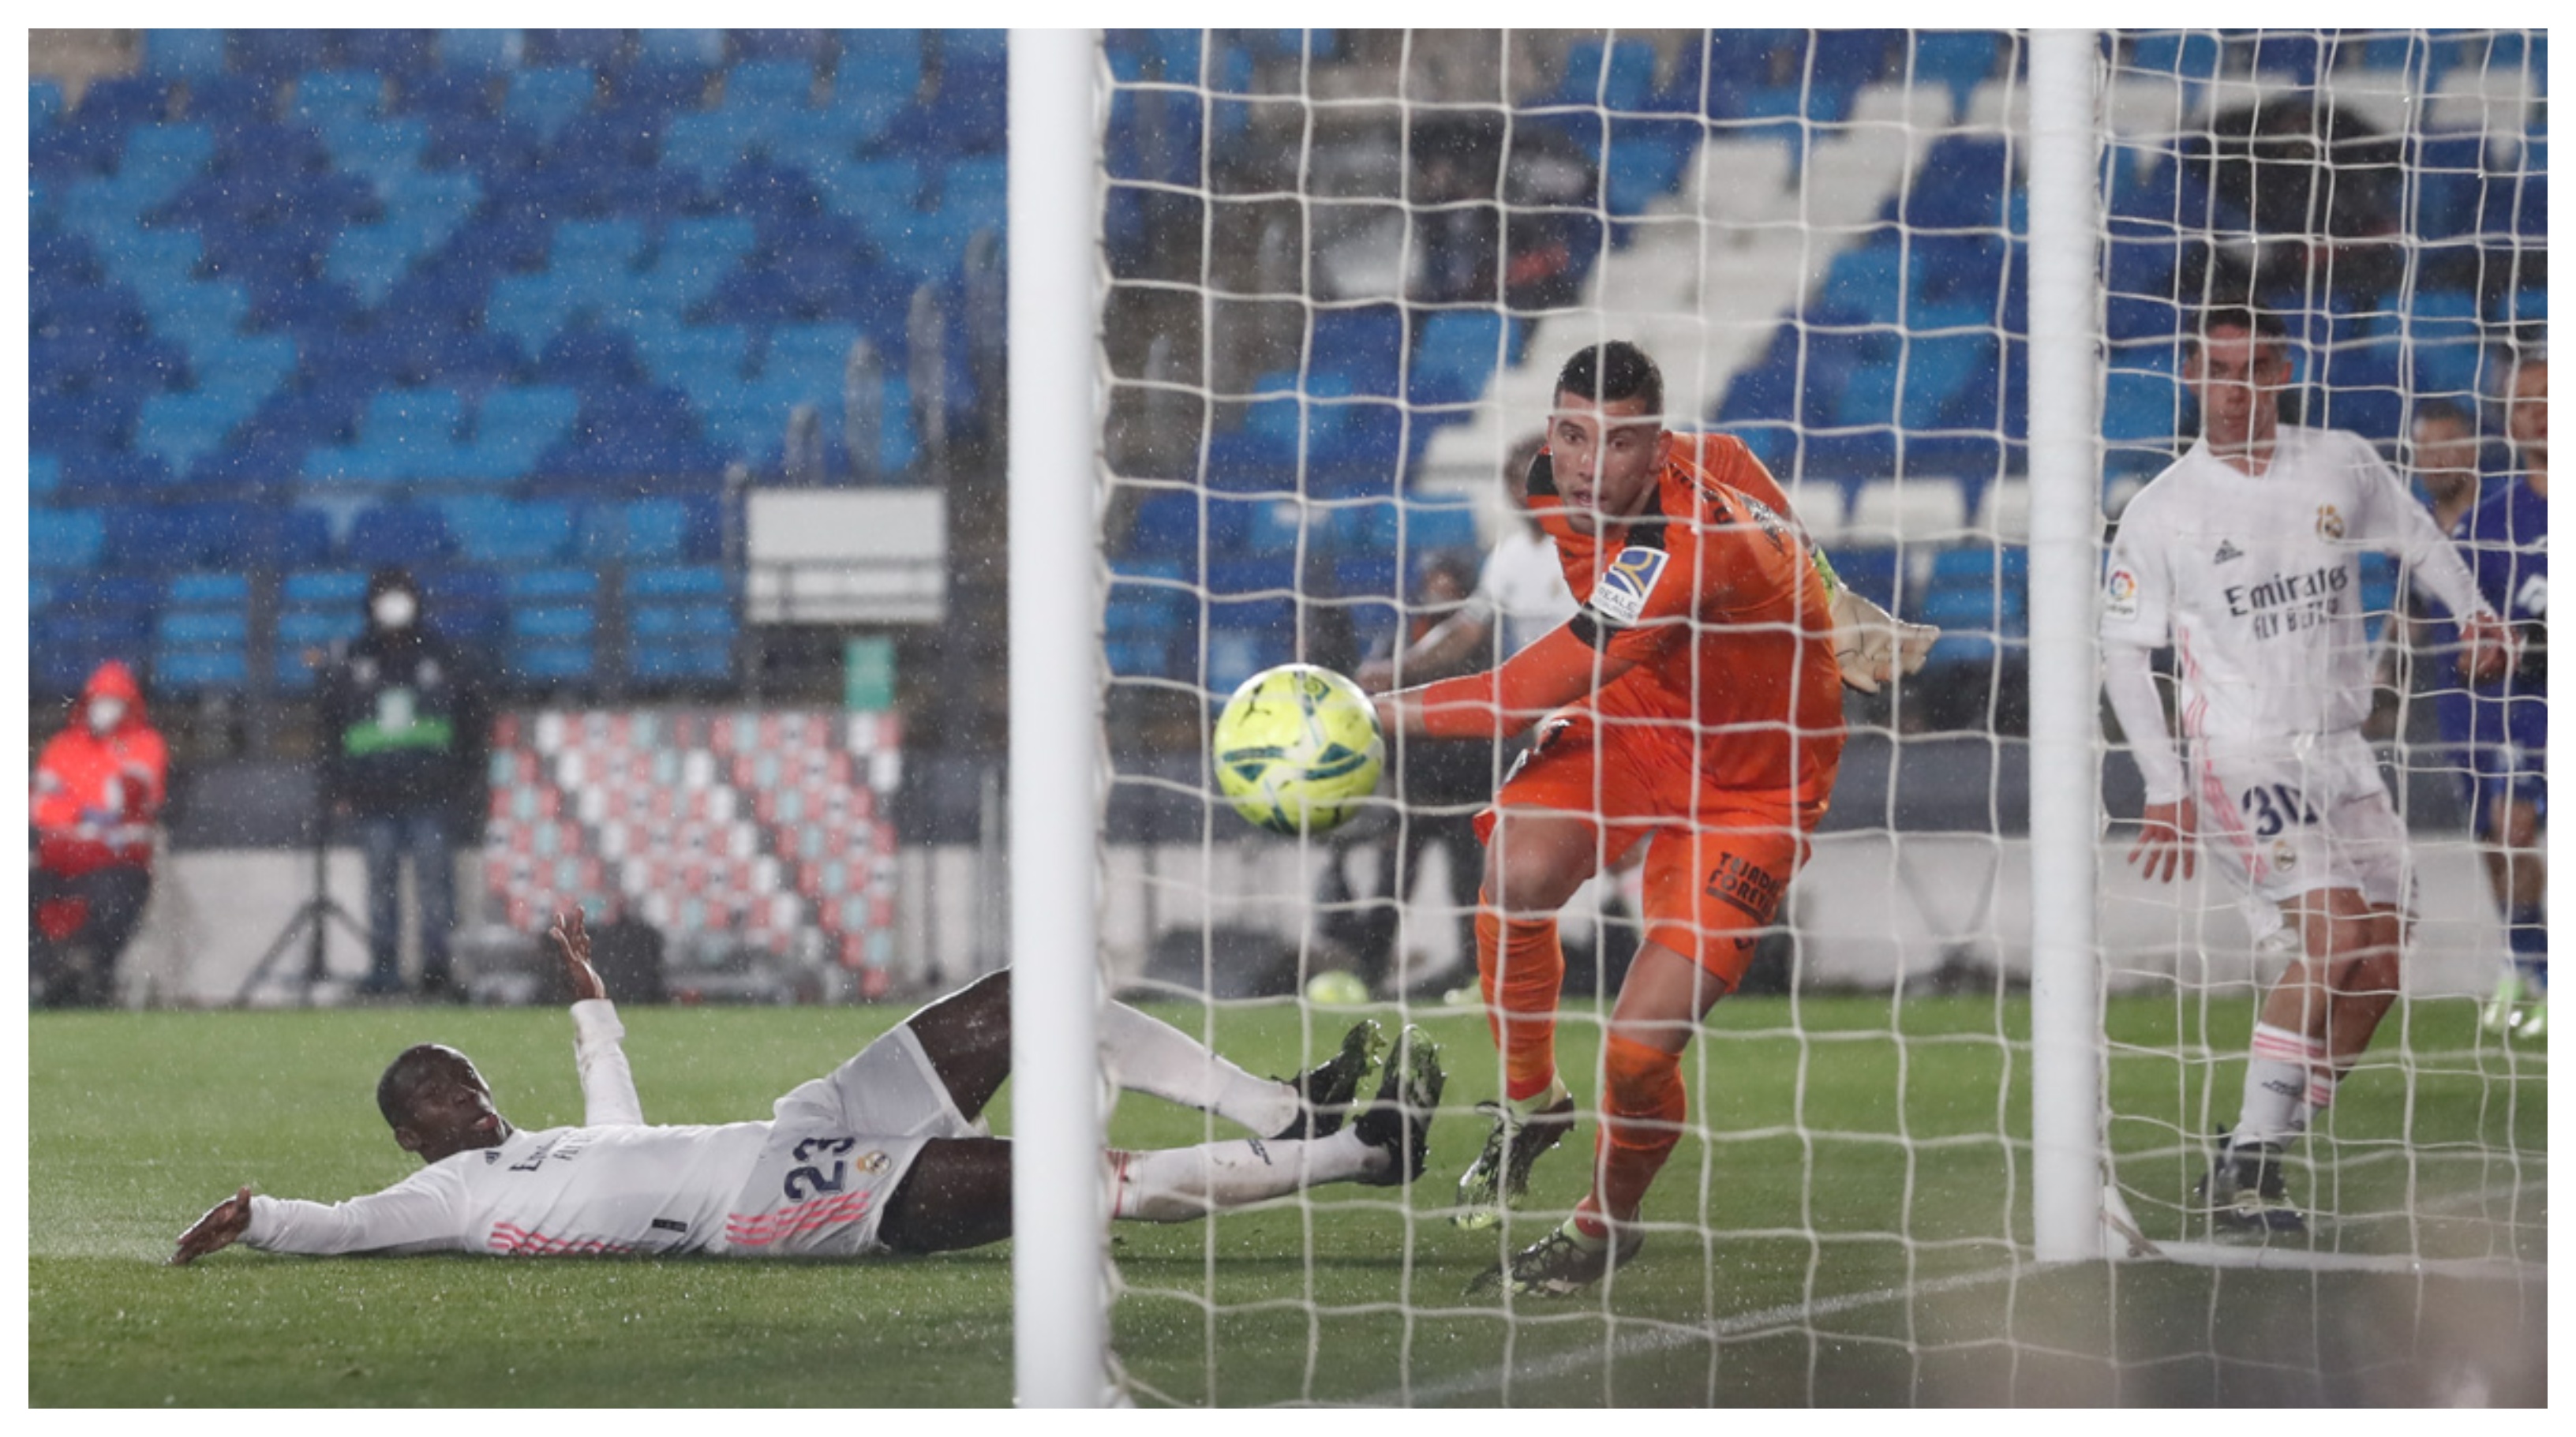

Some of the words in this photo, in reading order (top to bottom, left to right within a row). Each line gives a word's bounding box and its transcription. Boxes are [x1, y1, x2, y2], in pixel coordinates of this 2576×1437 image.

[2224, 564, 2348, 618] Emirates
[2241, 782, 2320, 838] 30
[784, 1136, 856, 1200] 23
